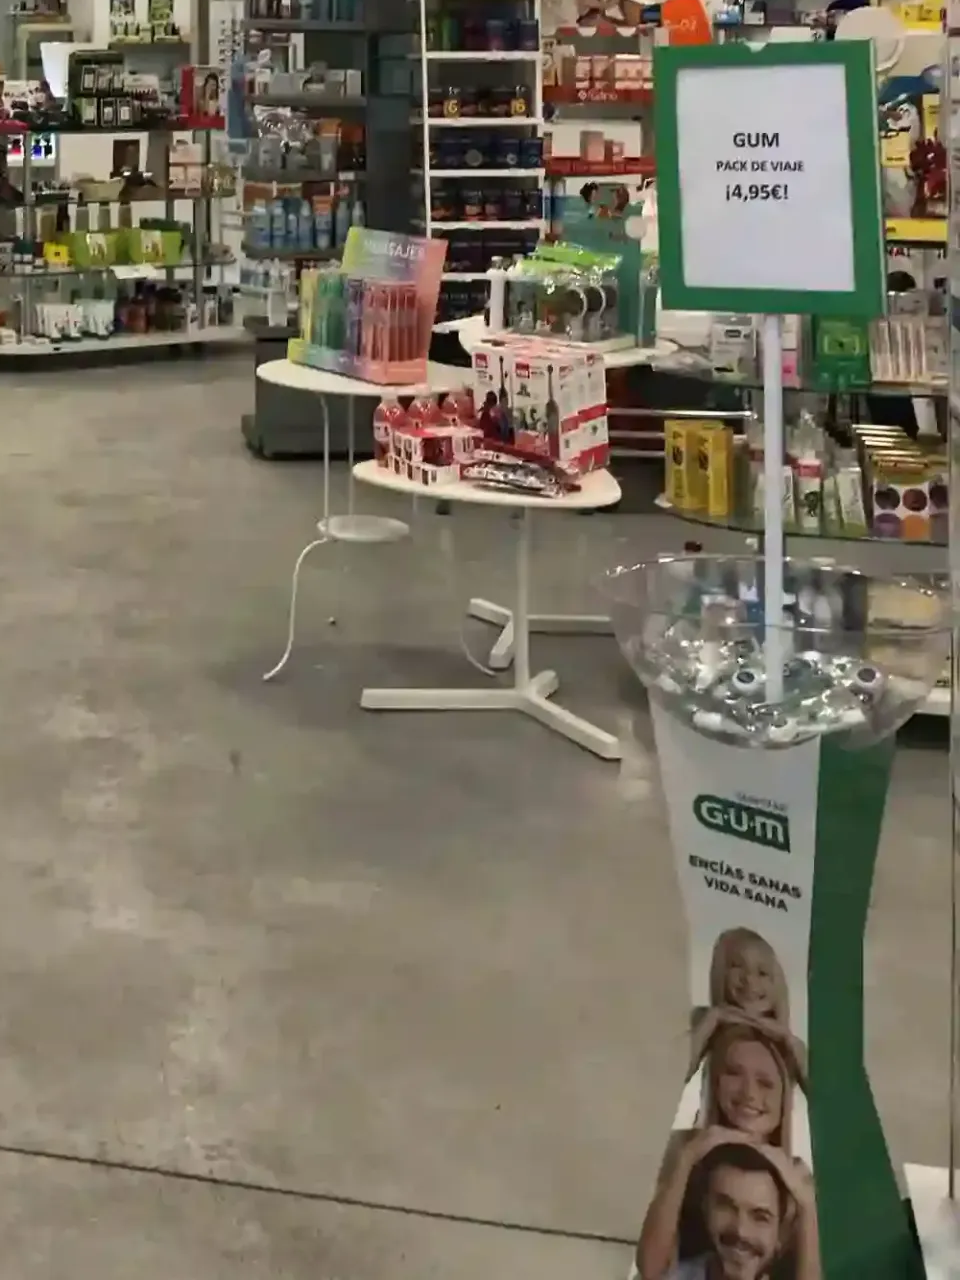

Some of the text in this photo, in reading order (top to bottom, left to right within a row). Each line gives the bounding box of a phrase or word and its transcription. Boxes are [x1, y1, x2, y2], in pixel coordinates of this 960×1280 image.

[733, 132, 780, 148] GUM
[716, 160, 804, 172] PACK DE VIAJE
[726, 183, 788, 202] ¡4,95€!
[689, 854, 802, 899] ENCÍAS SANAS
[704, 875, 788, 913] VIDA SANA
